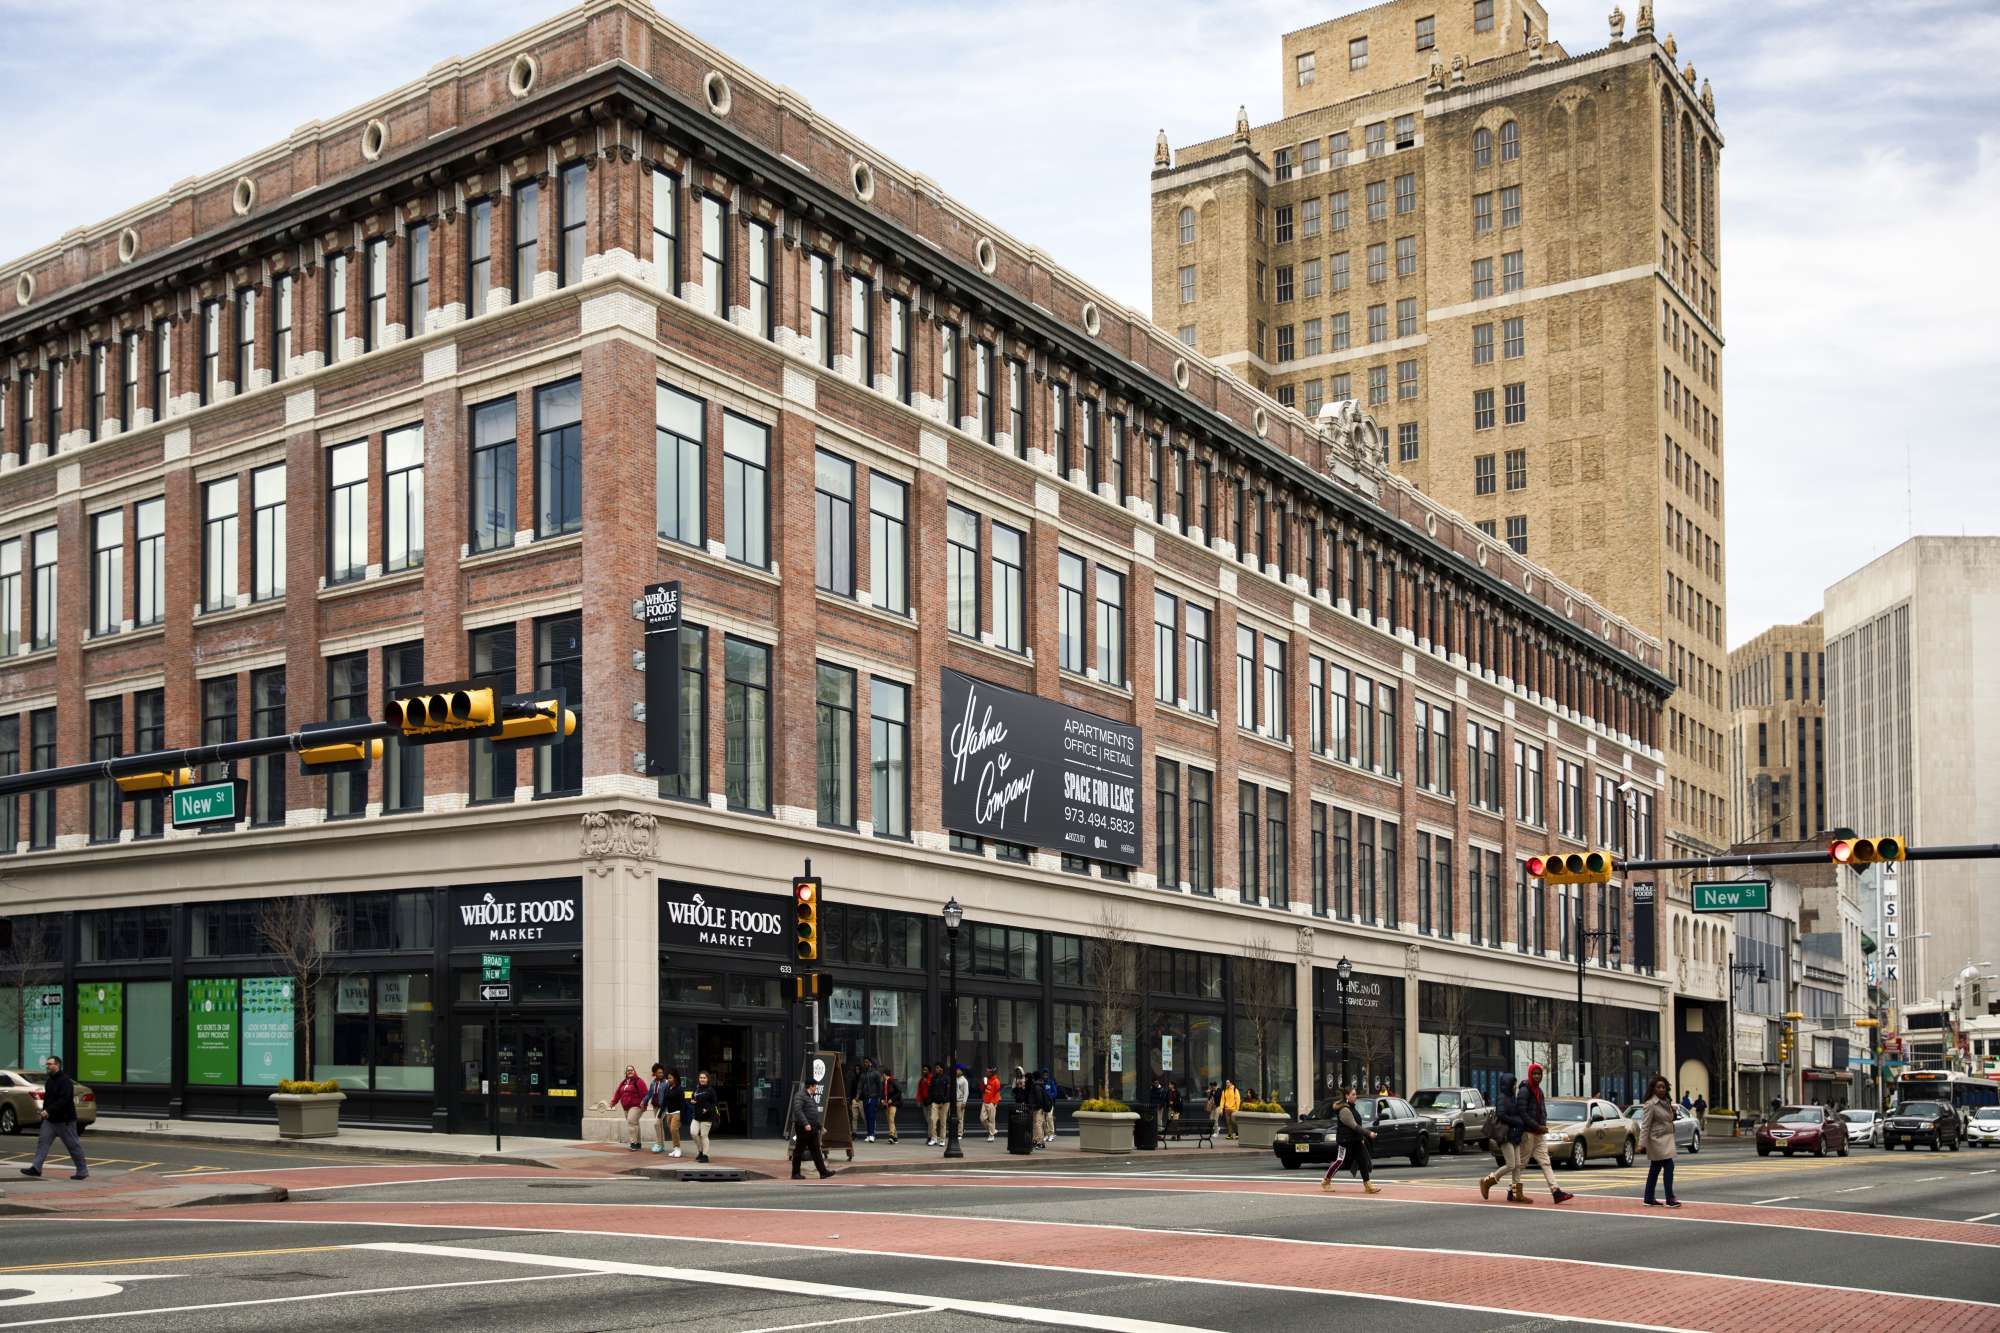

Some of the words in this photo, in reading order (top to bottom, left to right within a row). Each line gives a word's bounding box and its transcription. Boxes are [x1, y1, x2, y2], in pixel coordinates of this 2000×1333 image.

[645, 590, 677, 605] WHOLE
[646, 602, 676, 617] FOODS
[650, 615, 672, 623] MARKET
[950, 685, 1008, 784] Hahne
[1064, 719, 1134, 750] APARTMENTS
[998, 752, 1011, 776] &
[1064, 737, 1097, 757] OFFICE
[1104, 748, 1134, 767] RETAIL
[182, 796, 212, 816] New
[216, 792, 224, 802] St
[976, 761, 1034, 830] Company
[1064, 771, 1091, 804] SPACE
[1092, 779, 1108, 807] FOR
[1110, 783, 1134, 814] LEASE
[1064, 806, 1135, 835] 973.494.5832
[1704, 890, 1739, 904] New
[1745, 889, 1755, 897] St
[460, 899, 516, 925] WHOLE
[520, 899, 574, 923] FOODS
[667, 899, 726, 928] WHOLE
[730, 909, 782, 935] FOODS
[490, 928, 544, 940] MARKET
[700, 932, 752, 947] MARKET
[483, 956, 502, 966] BROAD
